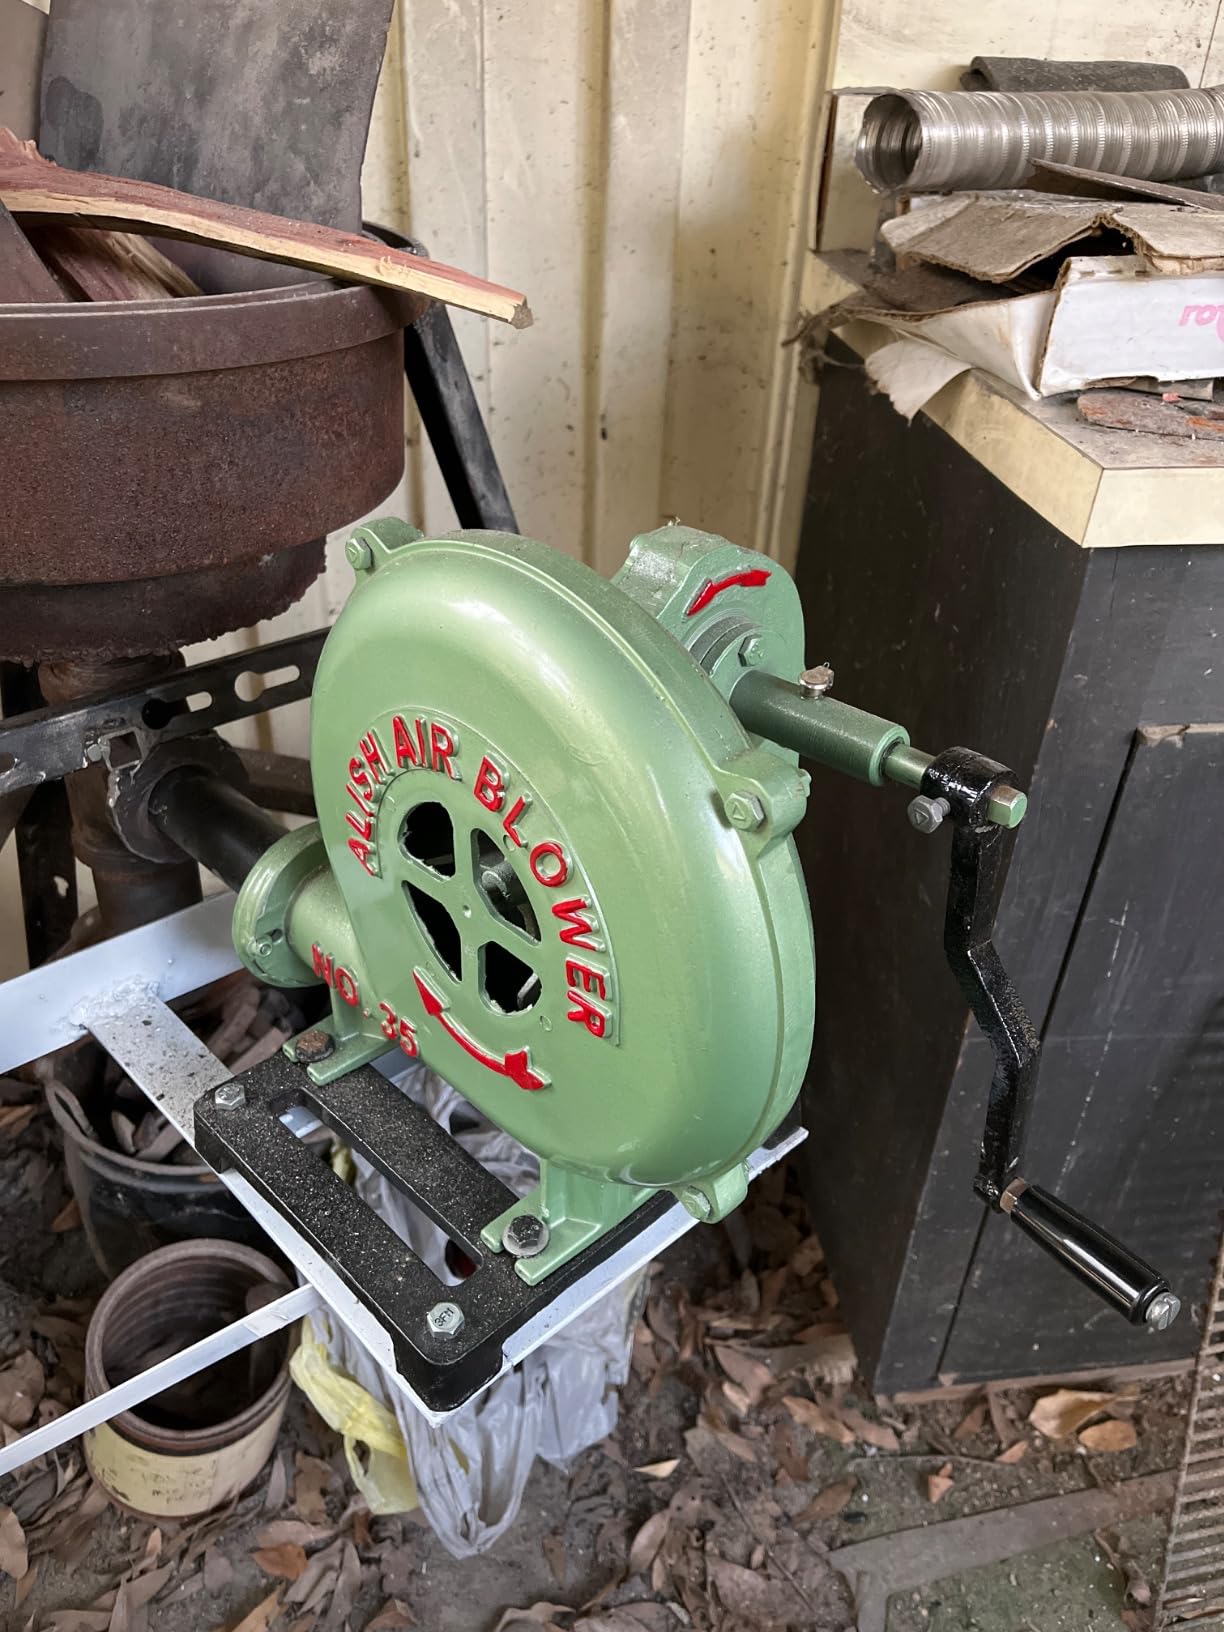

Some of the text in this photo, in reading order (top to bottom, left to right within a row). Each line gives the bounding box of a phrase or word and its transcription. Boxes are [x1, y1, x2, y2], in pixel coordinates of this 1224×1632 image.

[345, 713, 612, 1039] ALISH AIR BLOWER
